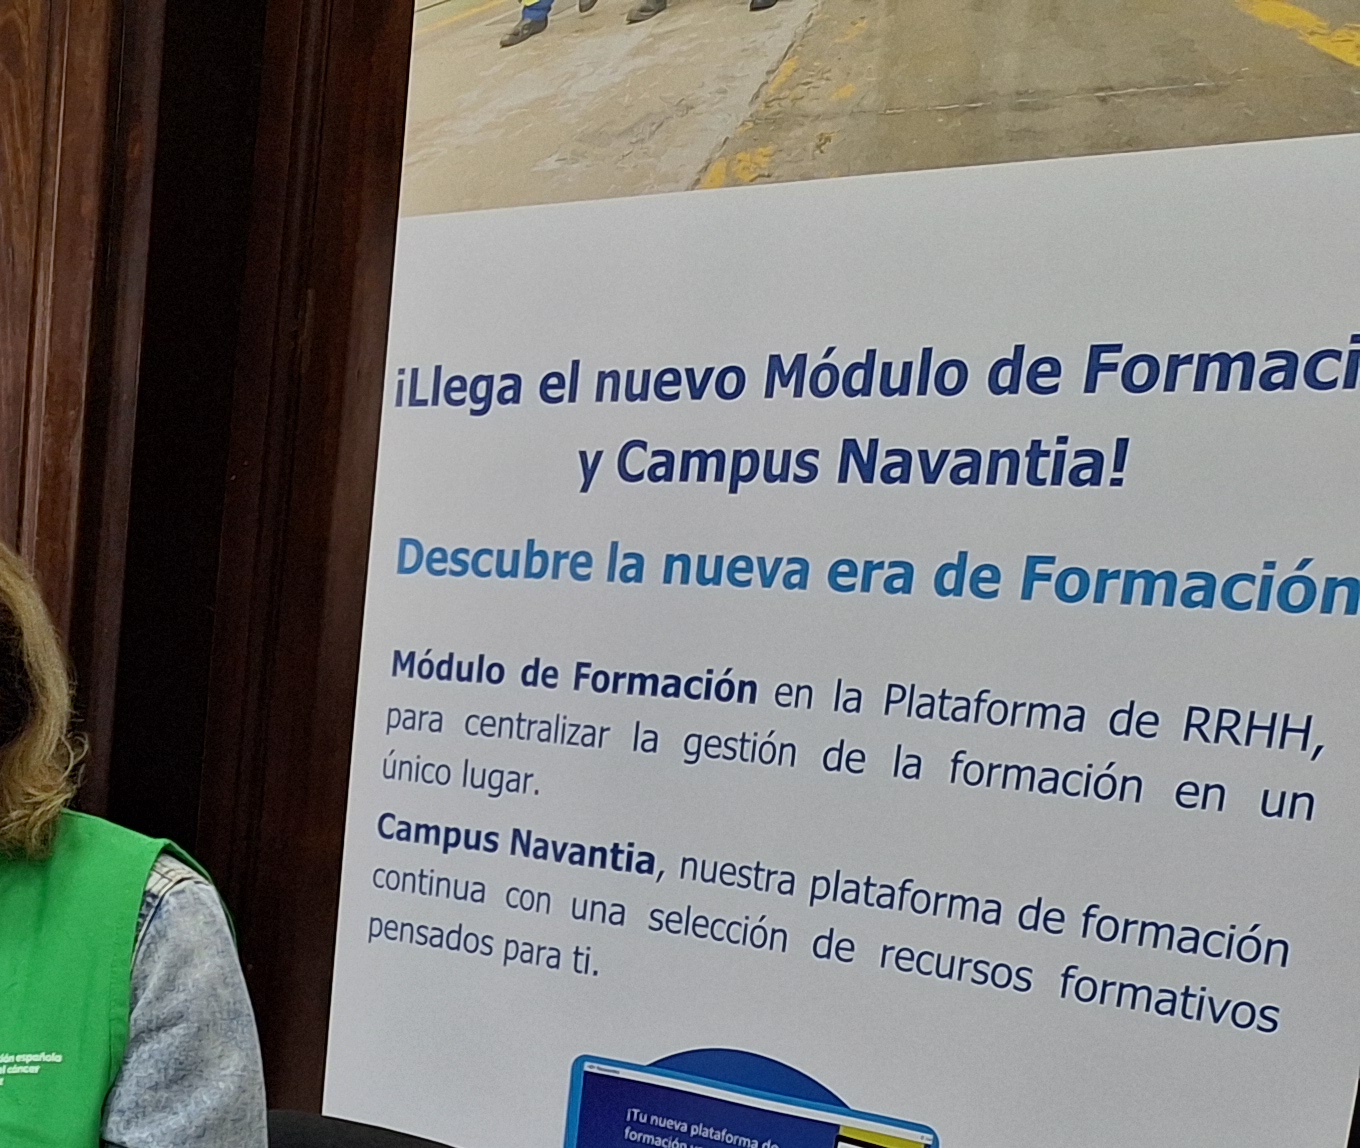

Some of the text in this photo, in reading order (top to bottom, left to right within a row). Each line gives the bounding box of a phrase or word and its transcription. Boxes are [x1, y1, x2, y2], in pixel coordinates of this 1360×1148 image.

[396, 365, 521, 416] ¡Llega
[540, 360, 580, 404] el
[596, 366, 745, 402] nuevo
[765, 347, 968, 398] Módulo
[988, 344, 1061, 395] de
[579, 436, 1129, 494] y Campus Navantia!
[397, 538, 1360, 615] Descubre la nueva era de Formación
[393, 649, 1323, 761] Módulo de Formación en la Plataforma de RRHH,
[383, 749, 538, 797] único lugar.
[387, 708, 1314, 820] para centralizar la gestión de la formación en un
[378, 813, 1288, 967] Campus Navantia, nuestra plataforma de formación
[369, 917, 597, 976] pensados para ti.
[373, 868, 1279, 1032] continua con una selección de recursos formativos
[650, 1115, 688, 1133] nueva
